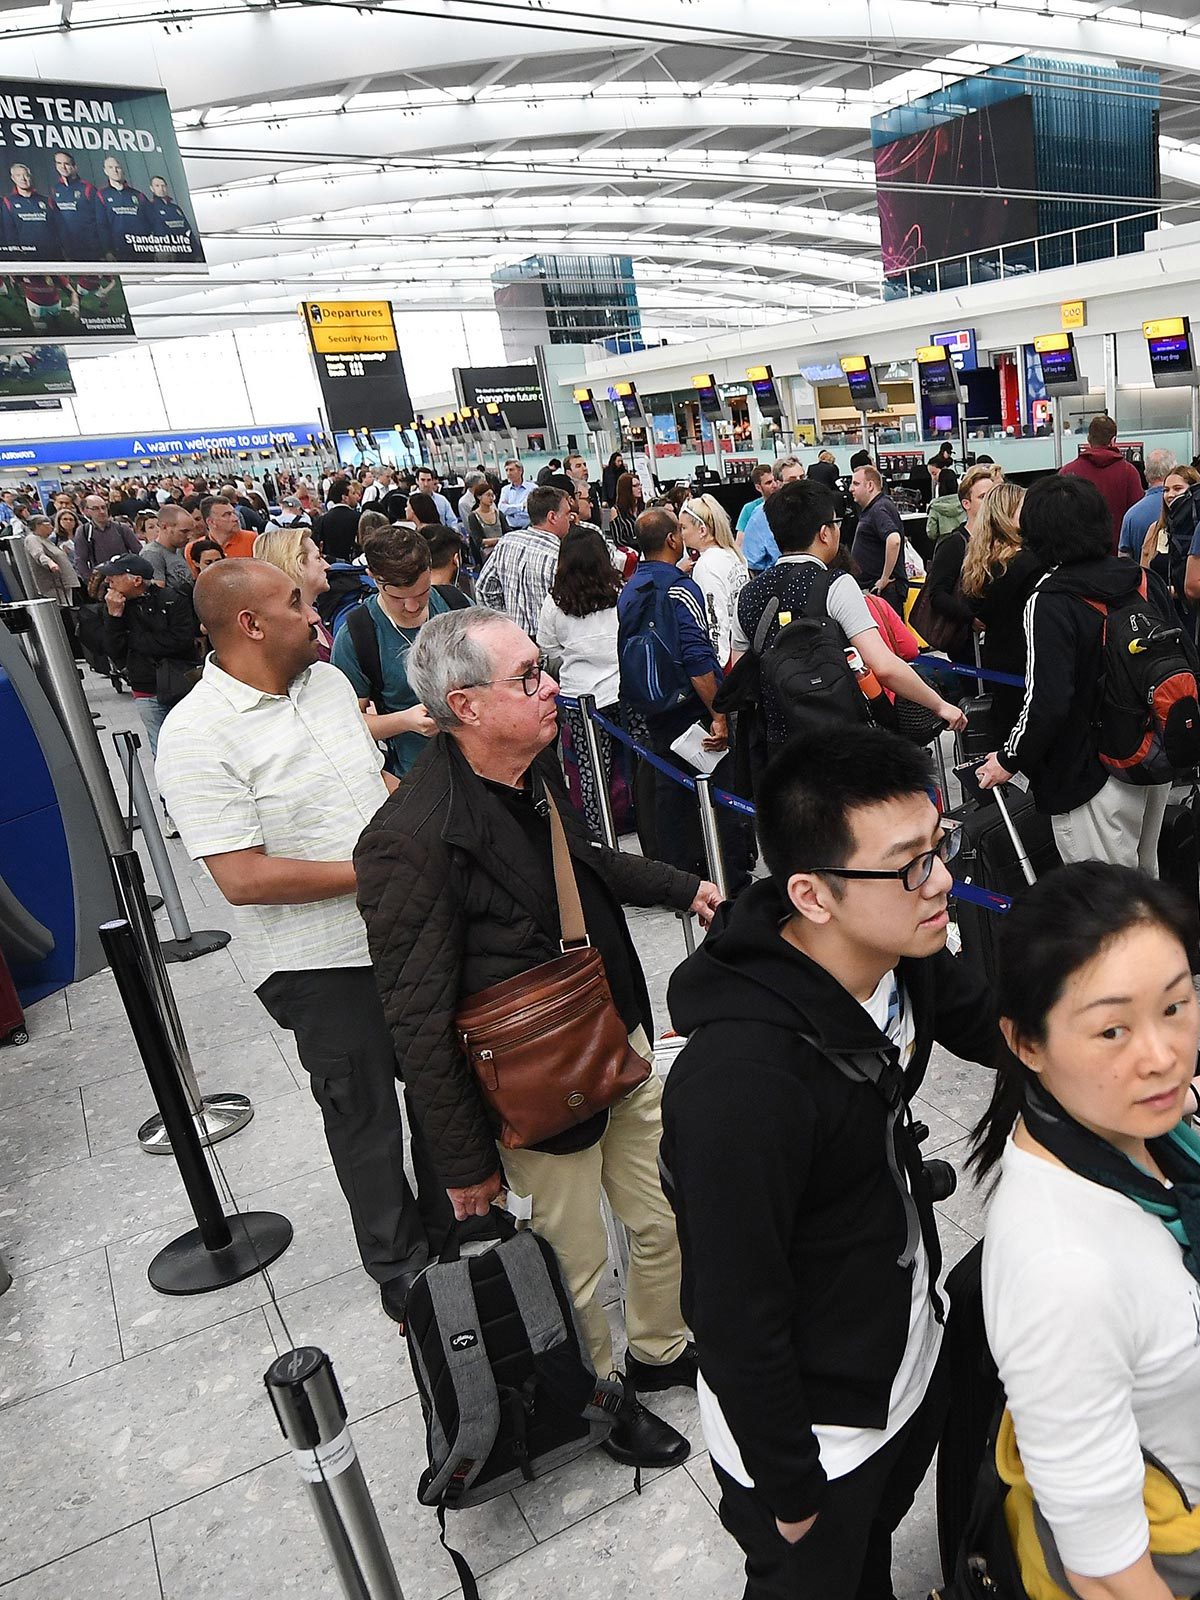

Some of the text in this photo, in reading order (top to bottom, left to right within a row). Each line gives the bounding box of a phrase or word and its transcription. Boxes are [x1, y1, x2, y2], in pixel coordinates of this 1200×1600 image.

[36, 97, 124, 125] TEAM.
[10, 123, 162, 153] STANDARD.
[125, 233, 190, 246] Standard Life
[133, 243, 193, 253] Investments
[323, 308, 383, 319] Departures
[328, 334, 388, 343] Security North
[476, 393, 503, 404] change
[503, 392, 516, 403] the
[133, 440, 146, 454] A
[146, 440, 183, 453] warm
[184, 434, 237, 449] welcome
[237, 435, 251, 447] to
[251, 434, 269, 446] our
